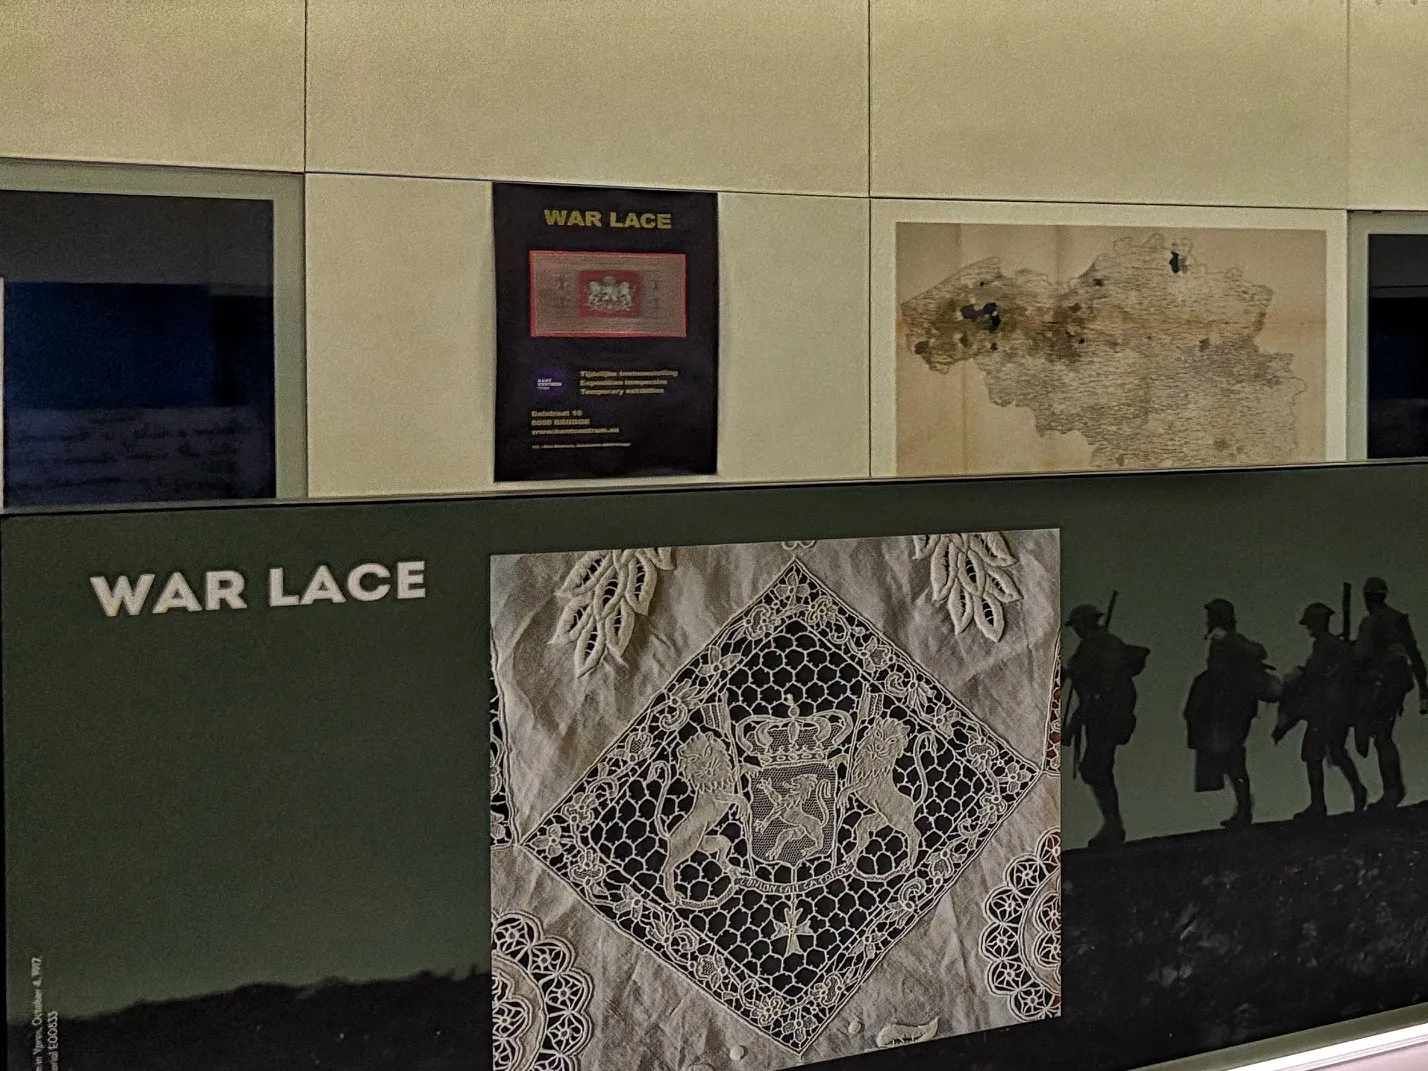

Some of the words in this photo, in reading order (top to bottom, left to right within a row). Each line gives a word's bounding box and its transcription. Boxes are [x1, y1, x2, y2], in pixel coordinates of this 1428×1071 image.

[544, 210, 602, 227] WAR
[610, 212, 672, 229] LACE
[90, 570, 248, 617] WAR
[269, 560, 426, 607] LACE
